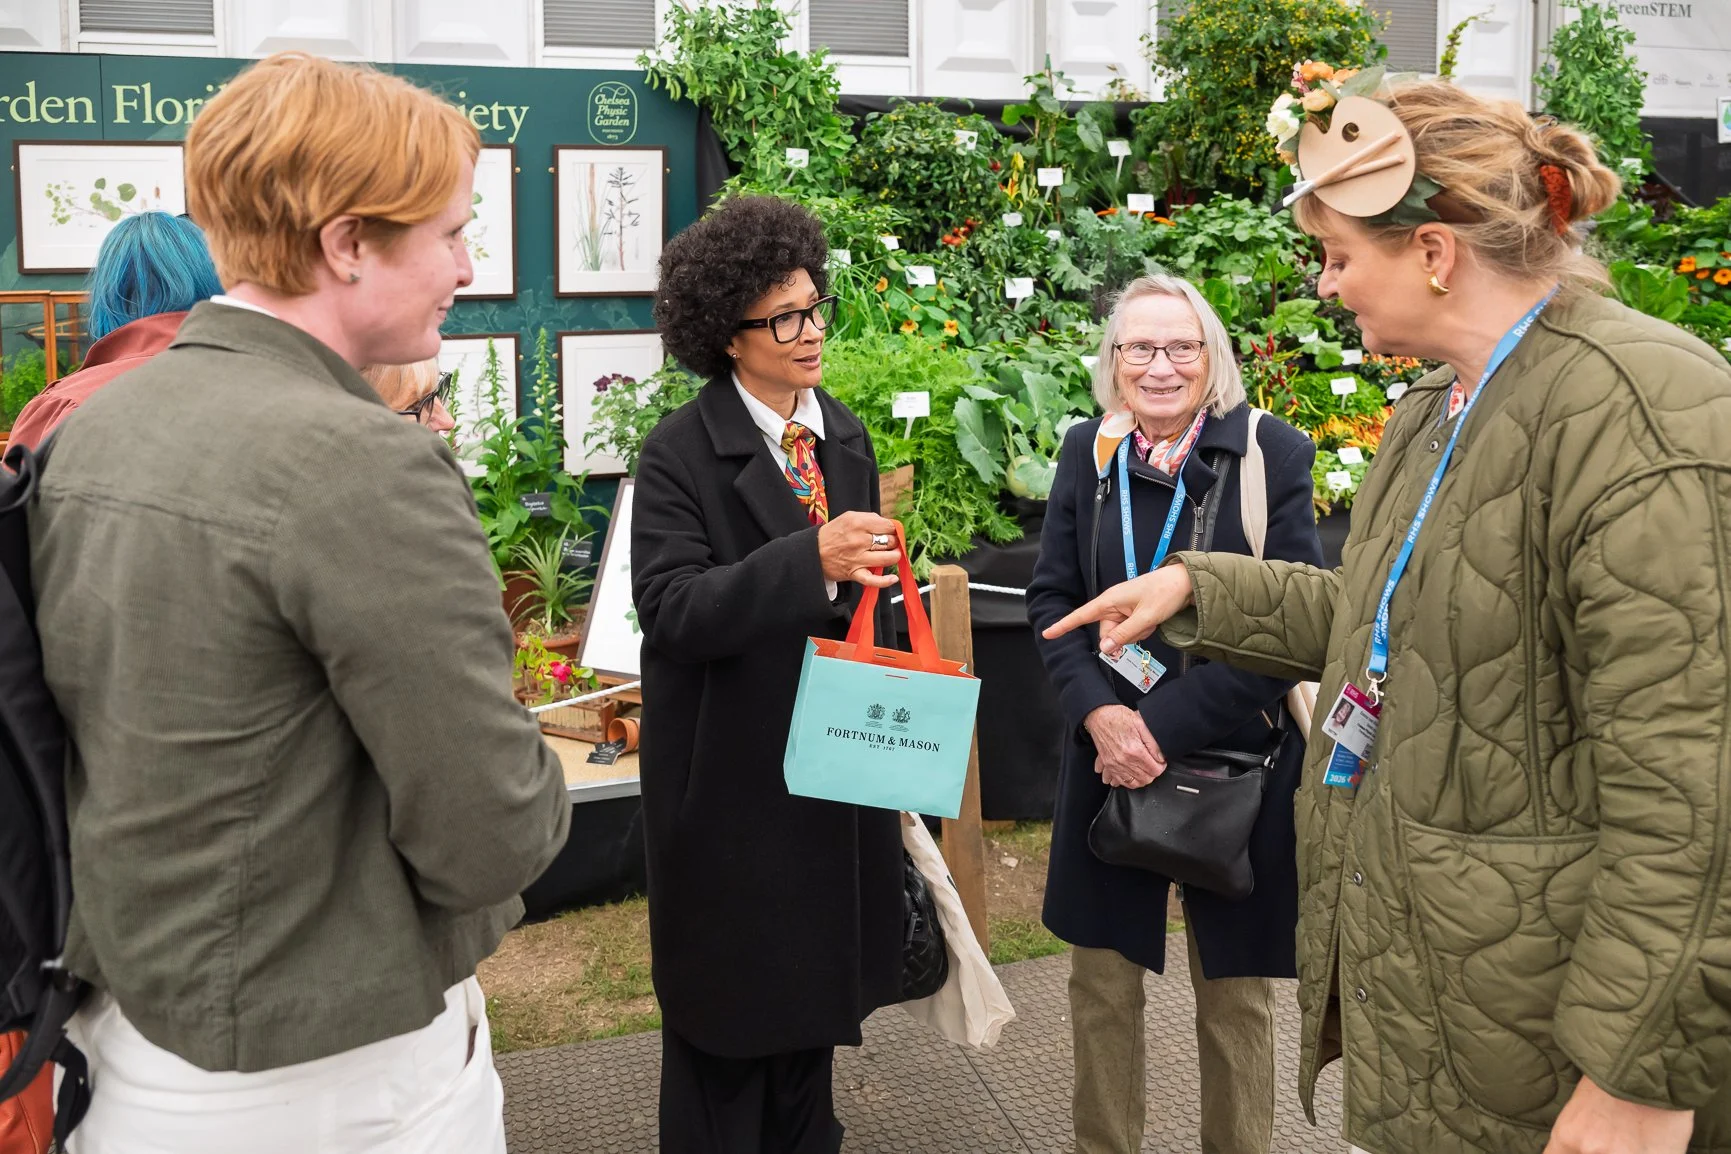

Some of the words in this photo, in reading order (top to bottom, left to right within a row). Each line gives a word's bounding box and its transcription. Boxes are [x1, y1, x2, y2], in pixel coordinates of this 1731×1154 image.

[1608, 0, 1692, 18] reenSTEM
[595, 90, 630, 105] Chelsea
[457, 91, 530, 143] iety
[597, 104, 628, 117] Physic
[595, 115, 630, 126] Garden
[1121, 489, 1129, 506] RHS
[1163, 523, 1174, 540] RHS
[1170, 494, 1184, 523] SHOWS
[1407, 521, 1421, 544] RHS
[1418, 477, 1439, 520] SHOWS
[1122, 507, 1131, 535] SHOWS
[1127, 562, 1136, 579] RHS
[826, 727, 886, 744] FORTNUM
[887, 736, 896, 746] &
[899, 738, 940, 752] MASON
